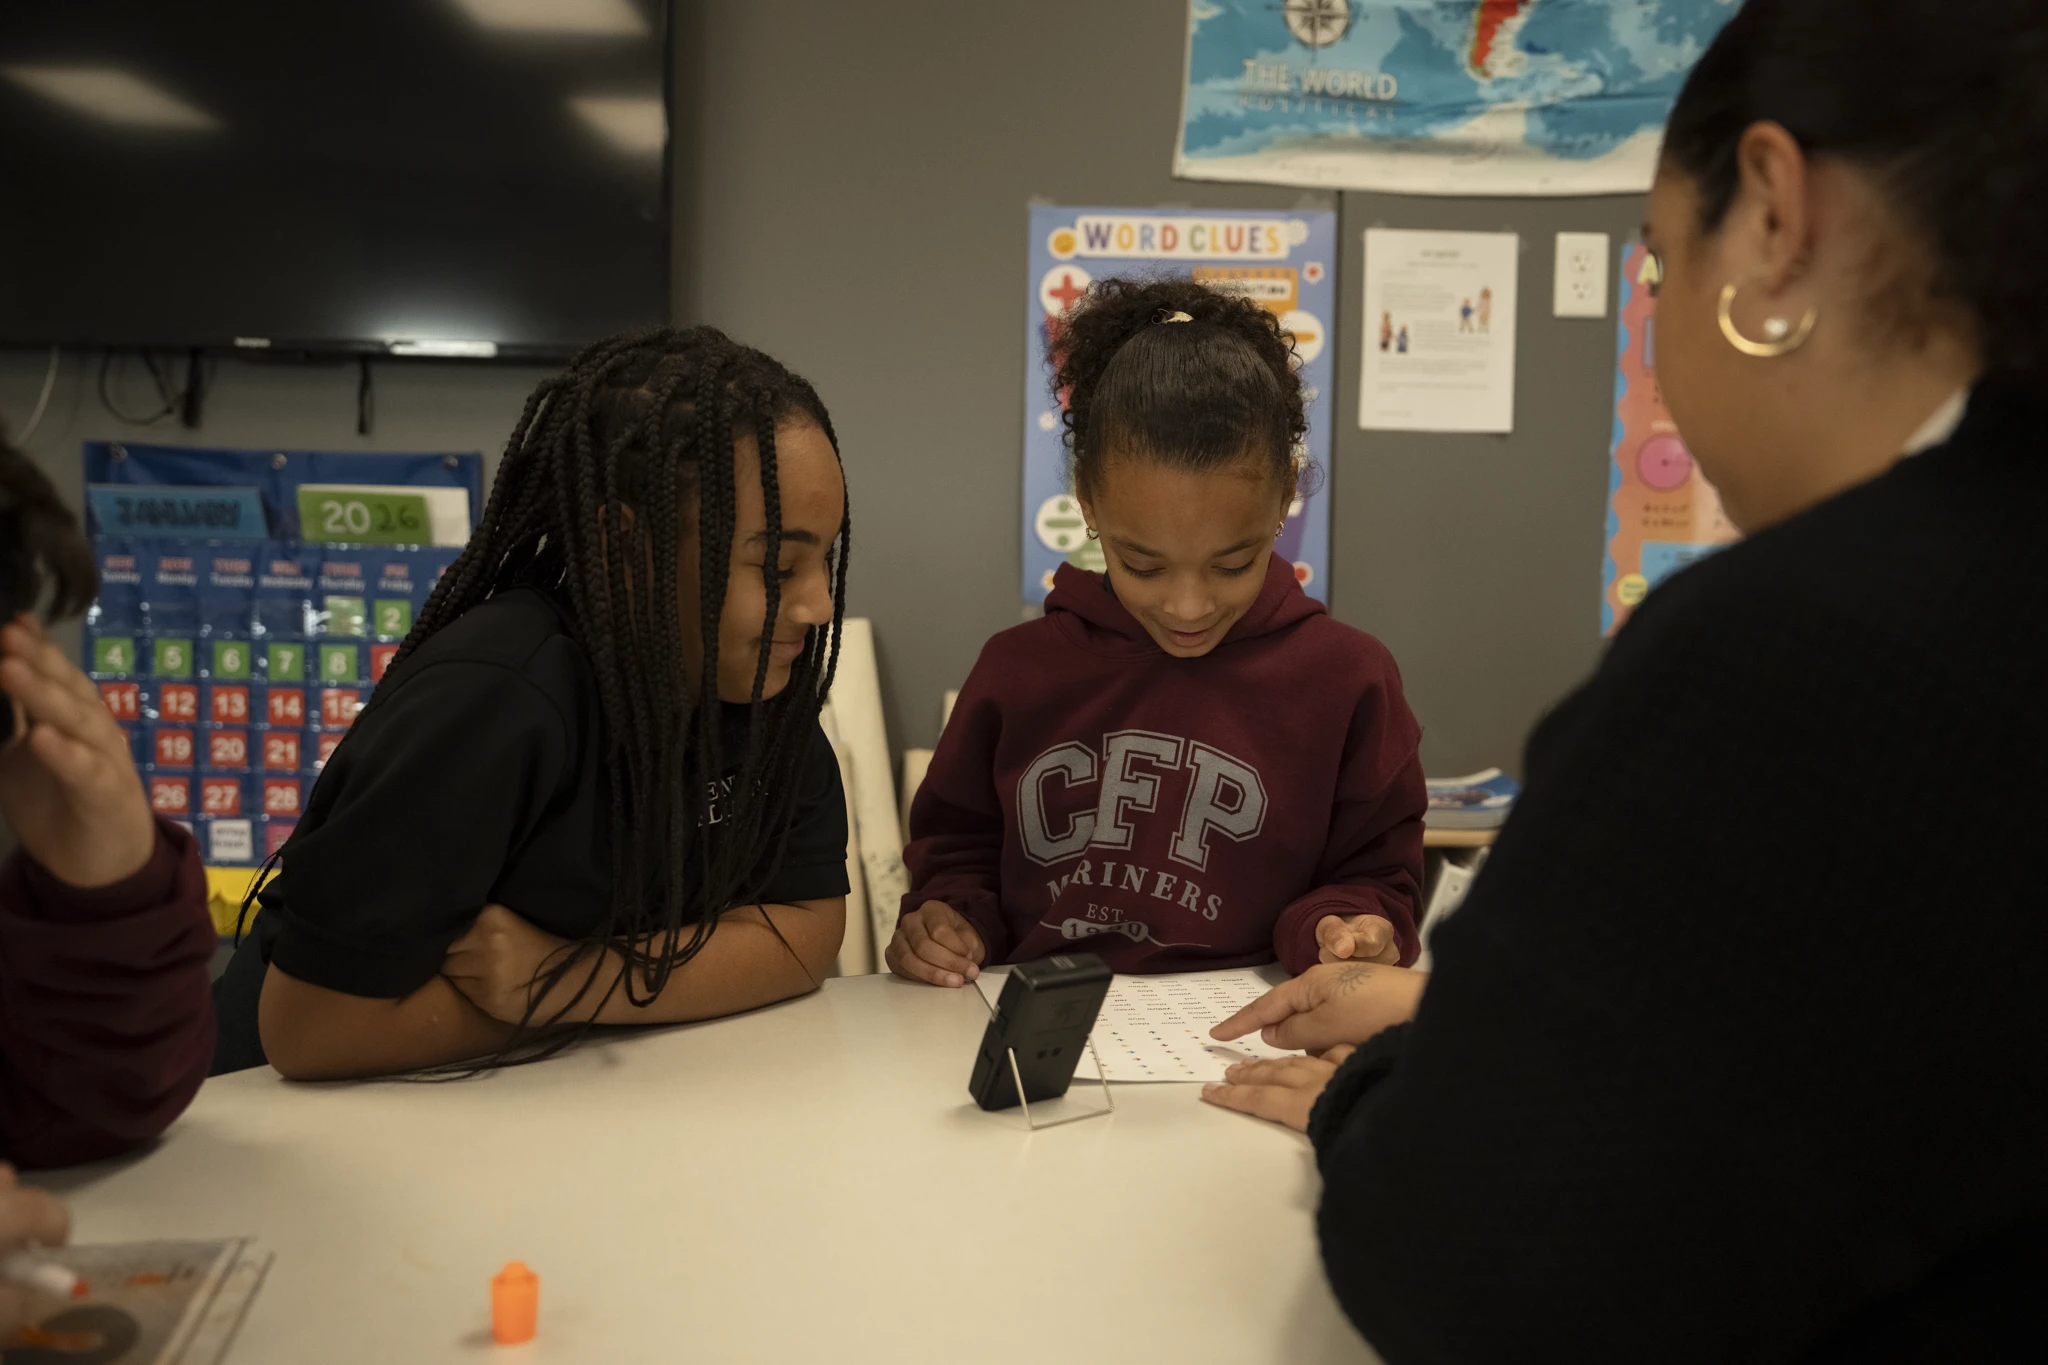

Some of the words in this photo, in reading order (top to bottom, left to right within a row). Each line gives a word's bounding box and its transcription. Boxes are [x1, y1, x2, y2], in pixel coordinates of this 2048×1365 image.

[1244, 59, 1289, 91] THE
[1302, 68, 1397, 100] WORLD
[1084, 223, 1178, 252] WORD
[1189, 225, 1280, 254] CLUES
[384, 607, 402, 631] 2
[105, 645, 124, 667] 4
[163, 645, 182, 670] 5
[221, 648, 241, 673] 6
[277, 650, 295, 673] 7
[329, 652, 347, 675] 8
[107, 690, 136, 713] 11
[164, 690, 196, 715] 12
[215, 692, 246, 717] 13
[272, 695, 301, 719] 14
[327, 696, 357, 720] 15
[160, 735, 191, 761] 19
[211, 736, 245, 762] 20
[268, 739, 297, 764] 21
[153, 783, 187, 808] 26
[205, 784, 238, 810] 27
[266, 786, 298, 811] 28
[1016, 729, 1269, 873] CFP
[1046, 859, 1223, 921] MRINERS
[1085, 903, 1128, 922] EST.
